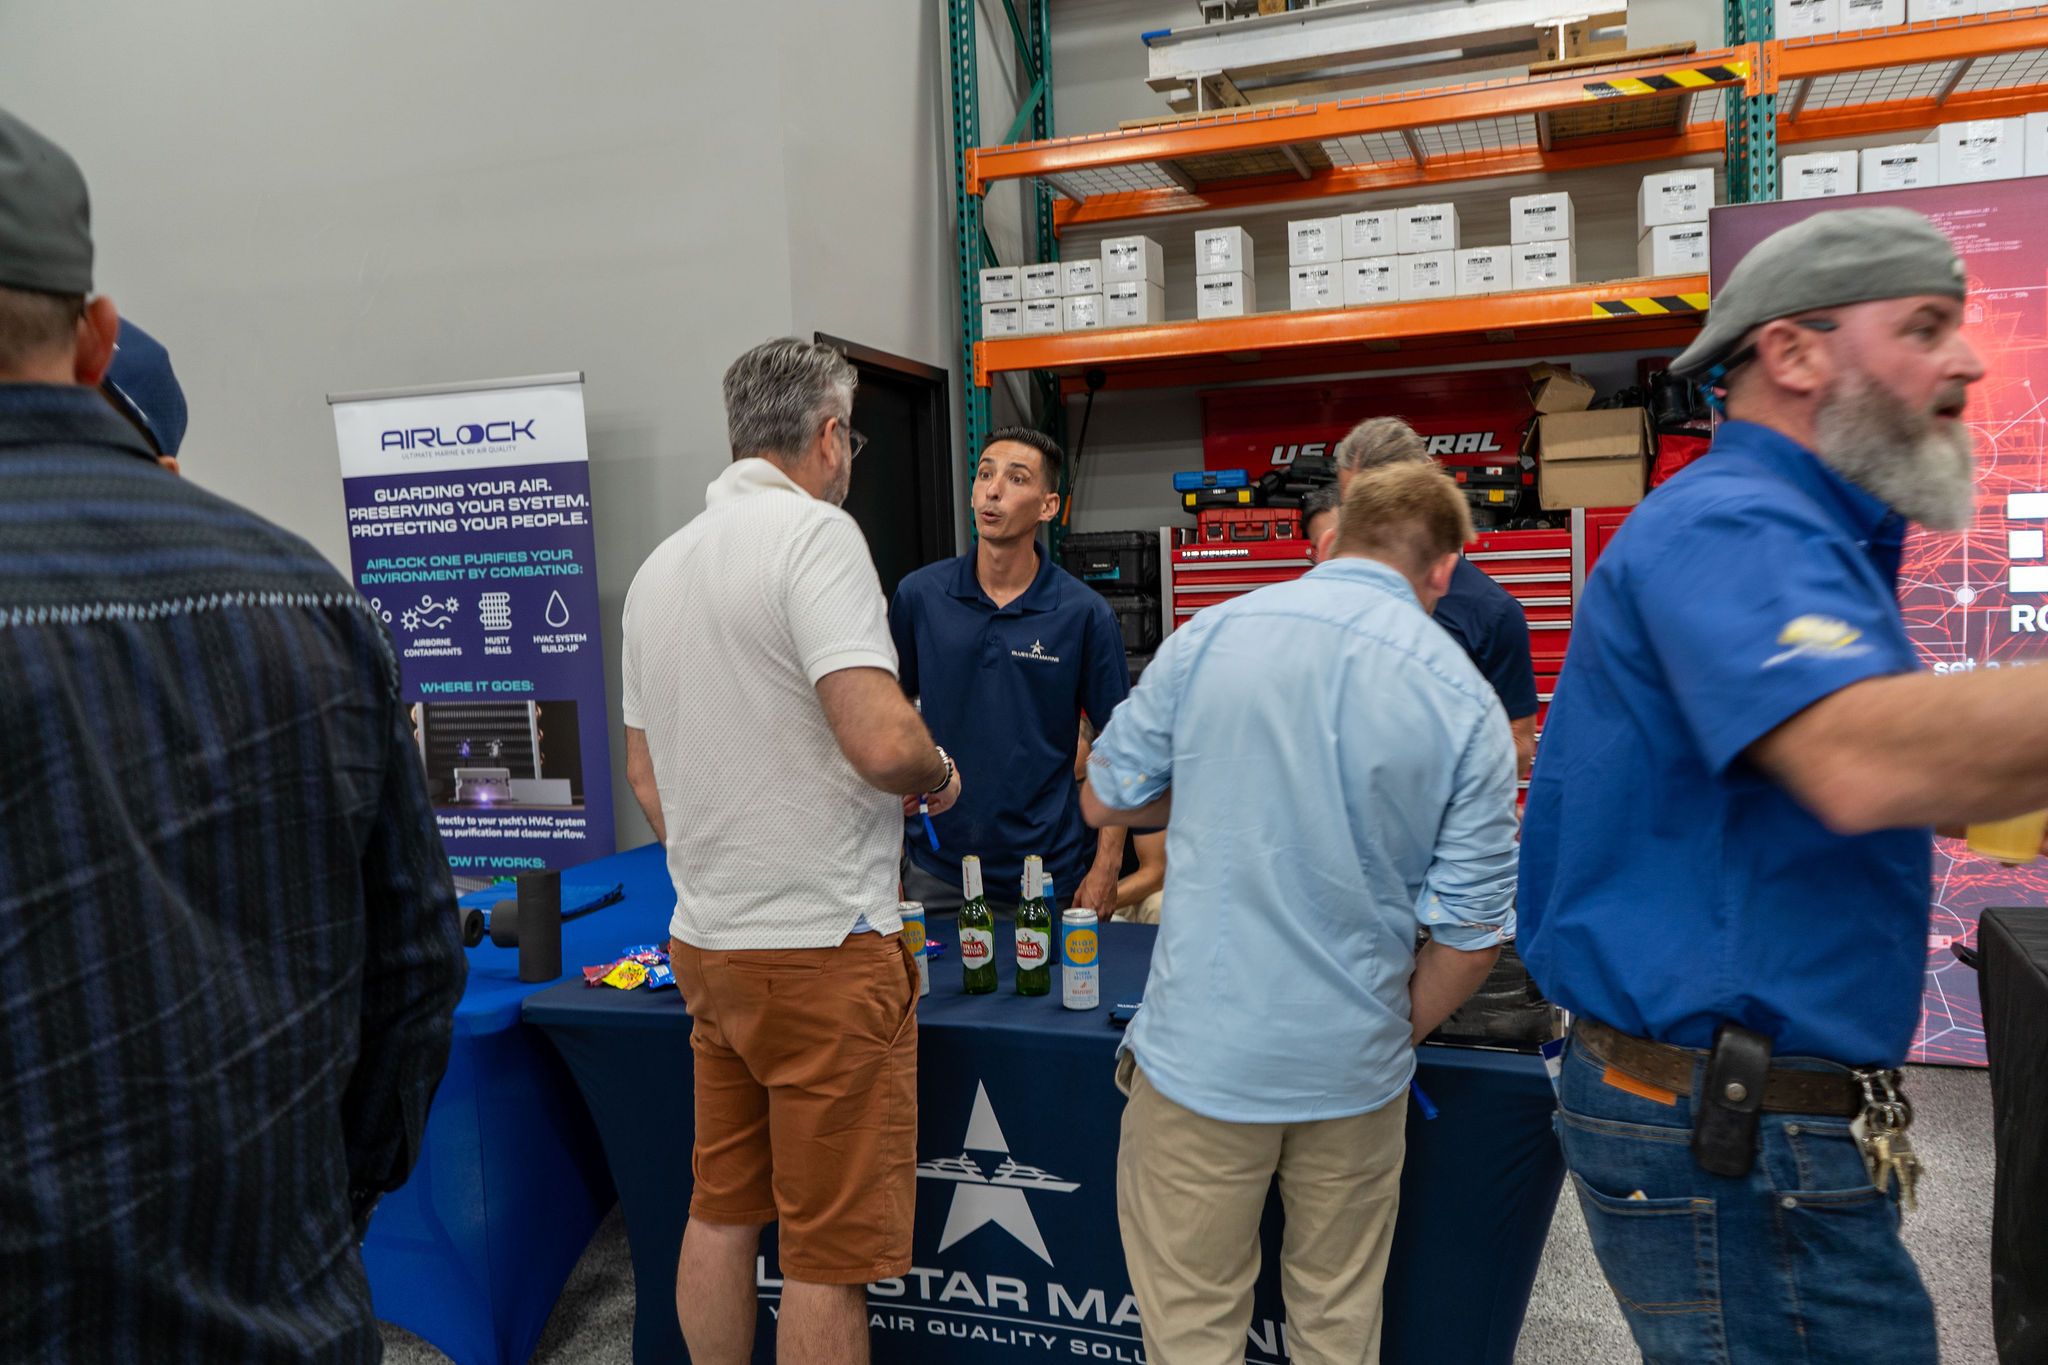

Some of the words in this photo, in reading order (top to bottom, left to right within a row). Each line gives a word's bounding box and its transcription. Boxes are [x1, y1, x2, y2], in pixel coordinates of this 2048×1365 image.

[381, 419, 536, 451] AIRLOCK
[401, 450, 432, 460] ULTIMATE
[434, 448, 459, 457] MARINE
[477, 446, 487, 454] AIR
[488, 445, 517, 454] QUALITY
[374, 484, 465, 503] GUARDING
[467, 480, 516, 496] YOUR
[518, 478, 553, 494] AIR.
[349, 501, 454, 521] PRESERVING
[456, 499, 505, 515] YOUR
[508, 494, 590, 512] SYSTEM.
[352, 519, 458, 538] PROTECTING
[460, 516, 509, 532] YOUR
[511, 511, 589, 529] PEOPLE.
[366, 556, 426, 571] AIRLOCK
[429, 554, 461, 567] ONE
[464, 551, 528, 565] PURIFIES
[530, 549, 574, 561] YOUR
[361, 569, 466, 585] ENVIRONMENT
[468, 567, 487, 580] BY
[490, 563, 584, 578] COMBATING:
[413, 638, 452, 648] AIRBORNE
[485, 636, 510, 646] MUSTY
[533, 635, 554, 644] HVAC
[555, 633, 587, 643] SYSTEM
[404, 647, 463, 658] CONTAMINANTS
[484, 646, 512, 656] SMELLS
[541, 643, 579, 654] BUILD-UP
[420, 681, 473, 694] WHERE
[476, 681, 489, 692] IT
[491, 680, 535, 692] GOES:
[467, 816, 477, 826] to
[477, 817, 498, 828] your
[498, 815, 528, 828] yacht's
[528, 816, 554, 826] HVAC
[555, 818, 587, 829] system
[455, 827, 503, 839] purification
[504, 828, 519, 838] and
[521, 828, 551, 839] cleaner
[552, 828, 587, 839] airflow.
[448, 856, 472, 867] OW
[475, 856, 488, 867] IT
[490, 856, 546, 869] WORKS:
[869, 1313, 915, 1332] AIR
[927, 1321, 1057, 1351] QUALITY
